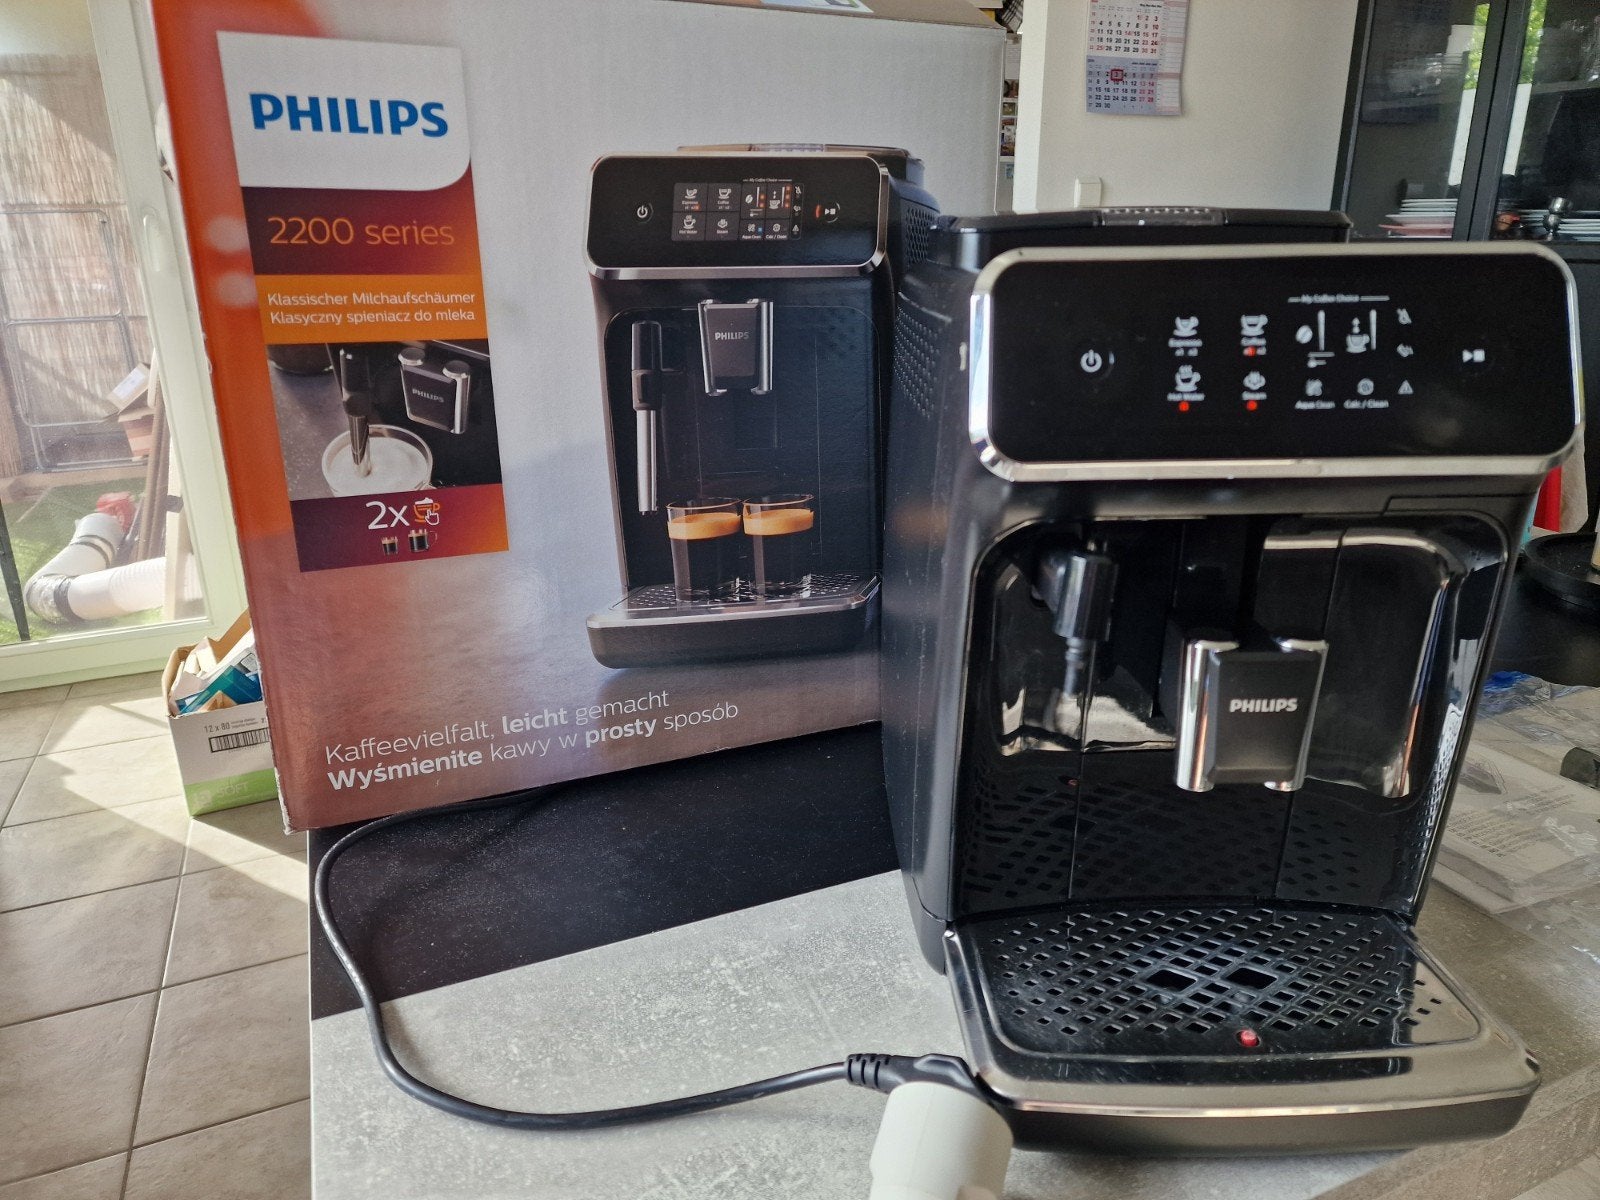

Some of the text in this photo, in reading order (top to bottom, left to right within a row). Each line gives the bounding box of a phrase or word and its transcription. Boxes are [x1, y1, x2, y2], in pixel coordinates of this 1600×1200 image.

[249, 92, 448, 138] PHILIPS
[268, 217, 454, 246] 2200 series
[268, 292, 475, 306] Klassischer Milchaufschäumer
[270, 308, 474, 326] Klasyczny spieniacz do mleka
[715, 332, 750, 340] PHILIPS
[412, 388, 444, 402] PHILIPS
[366, 502, 410, 530] 2x
[1230, 698, 1298, 712] PHILIPS
[326, 690, 670, 765] Kaffeevielfalt, leicht gemacht
[327, 702, 738, 790] Wyśmienite kawy w prosty sposób
